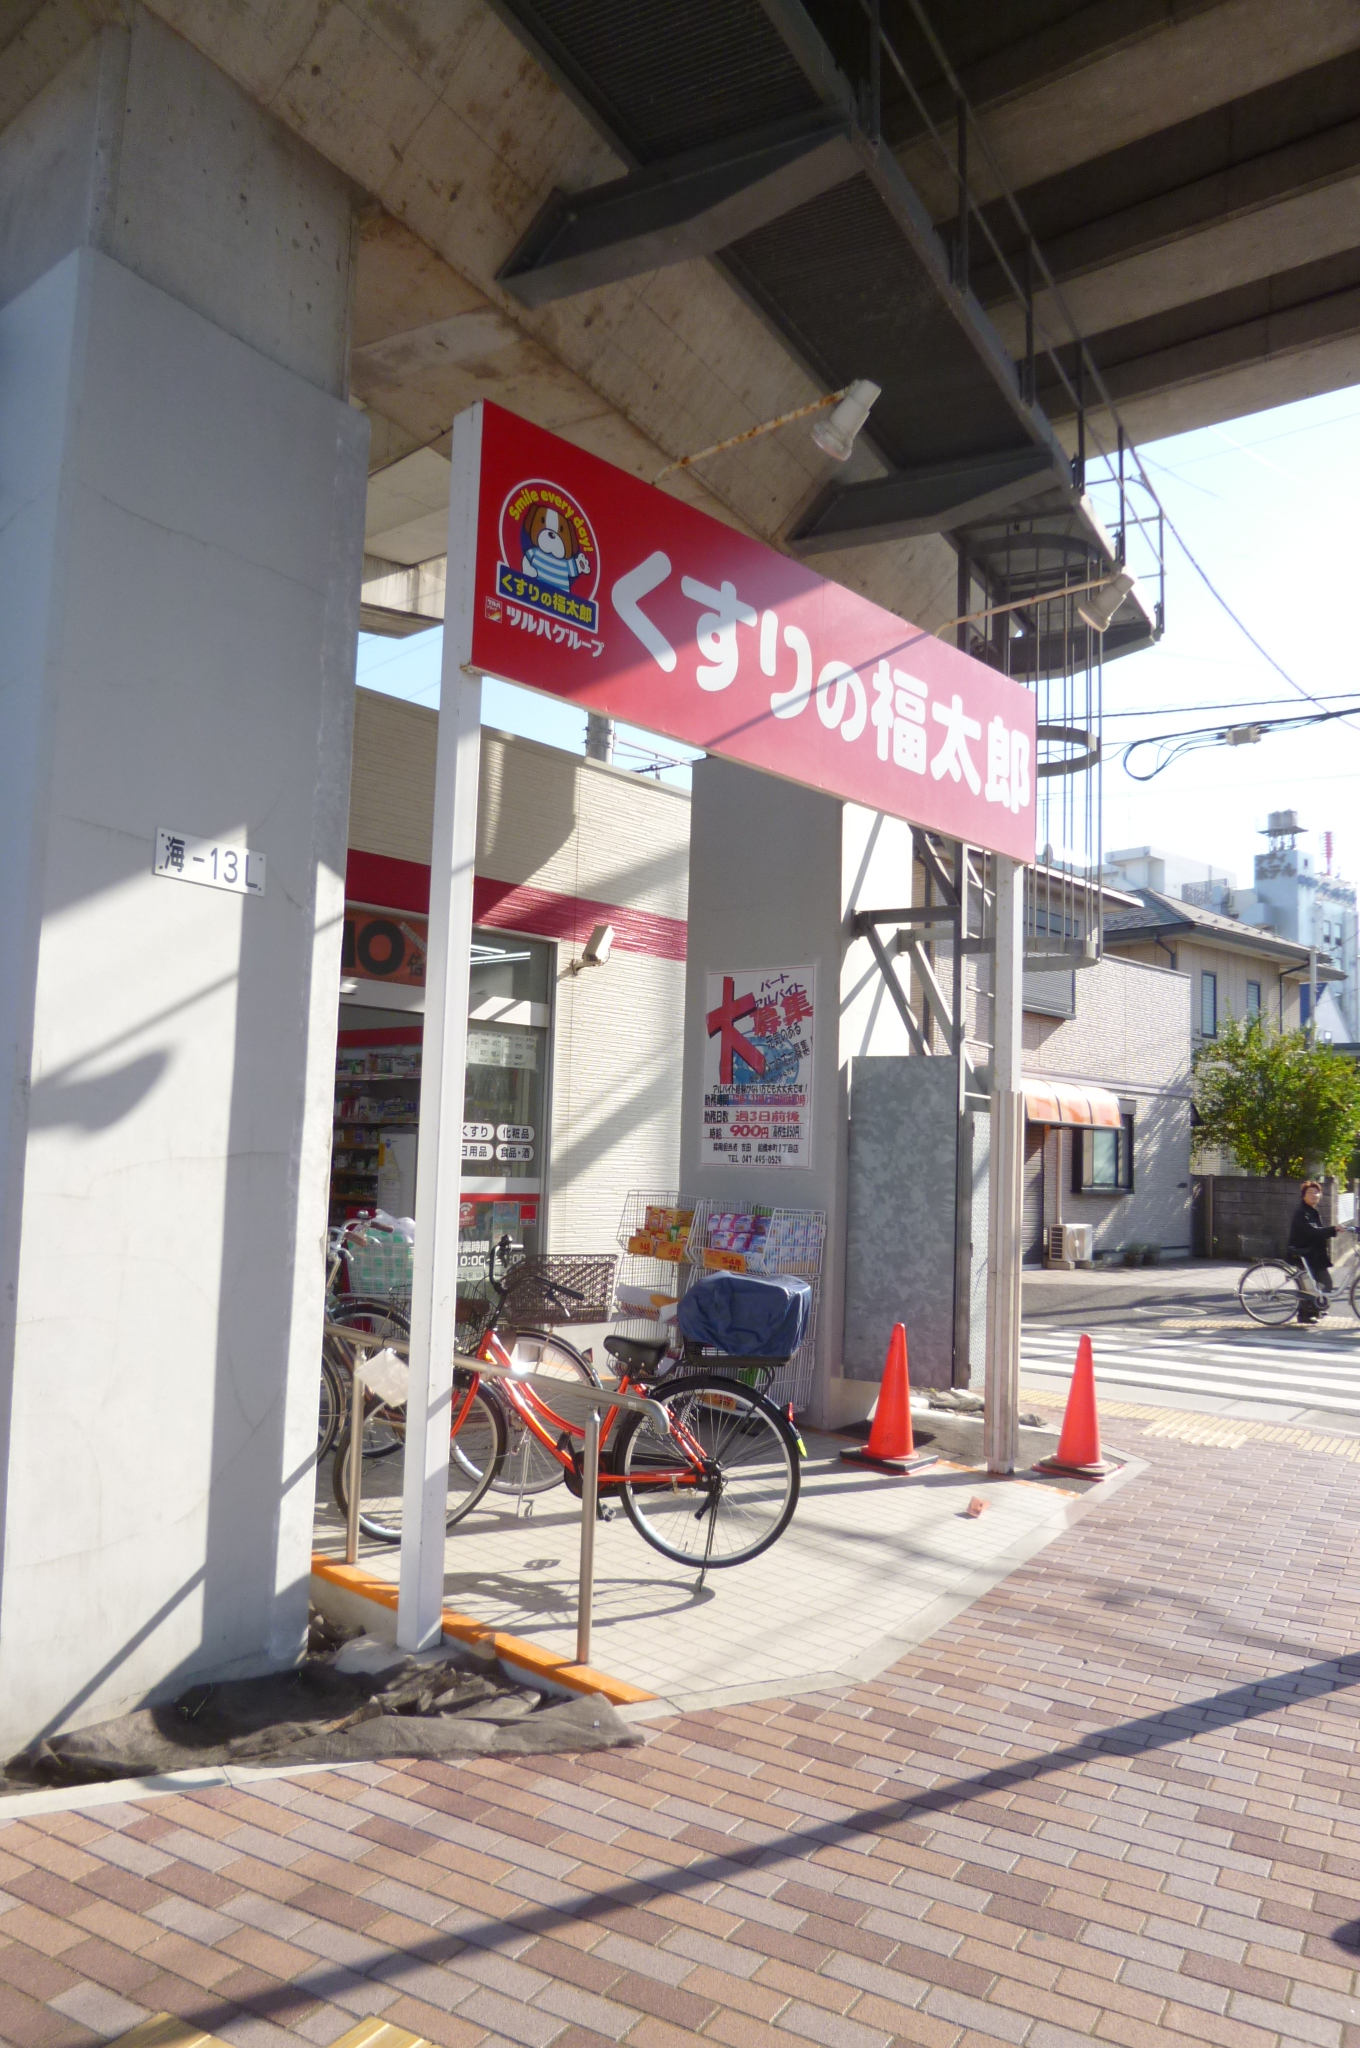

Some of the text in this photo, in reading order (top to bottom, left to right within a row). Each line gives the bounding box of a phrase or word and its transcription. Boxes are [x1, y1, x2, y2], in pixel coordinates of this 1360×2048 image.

[509, 488, 593, 552] Smile every day!
[502, 573, 592, 623] くすりの福太郎
[506, 605, 604, 657] ツルハグループ
[612, 551, 1030, 814] くすりの福太郎
[164, 836, 258, 889] 海-13L
[761, 973, 789, 992] パート
[755, 983, 803, 1009] アルバイト
[750, 989, 813, 1037] 募集
[735, 1111, 799, 1122] 週3日前後
[462, 1125, 488, 1138] くすり
[503, 1128, 529, 1139] 化粧品
[709, 1127, 722, 1139] 時給
[730, 1125, 768, 1138] 900円
[461, 1145, 487, 1157] 日用品
[728, 1155, 739, 1163] TEL
